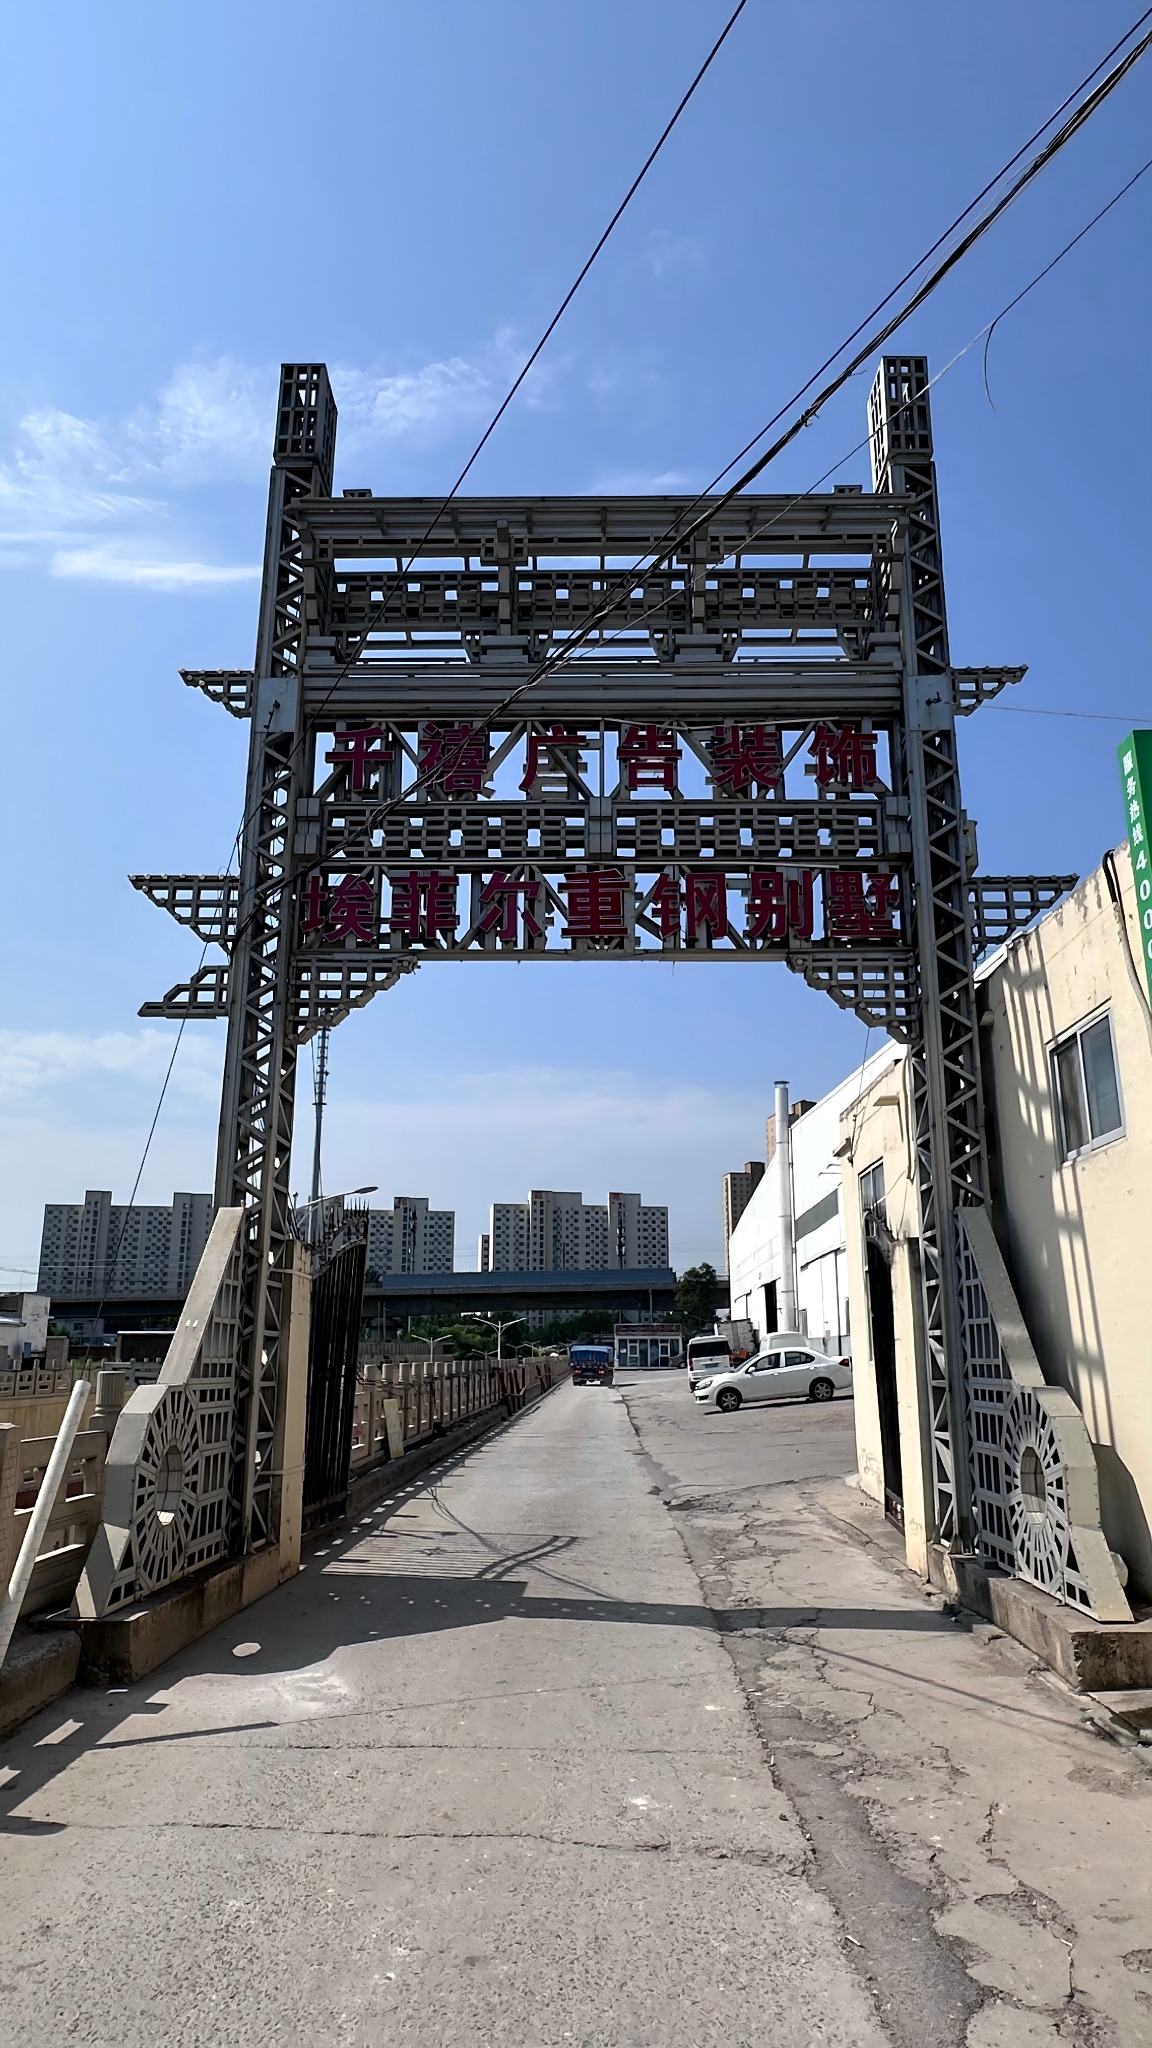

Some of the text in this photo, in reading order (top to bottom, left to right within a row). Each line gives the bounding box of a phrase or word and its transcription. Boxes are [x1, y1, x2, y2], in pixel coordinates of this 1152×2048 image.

[325, 722, 878, 792] 千禧广告装饰
[301, 870, 900, 942] 埃菲尔重钢别墅
